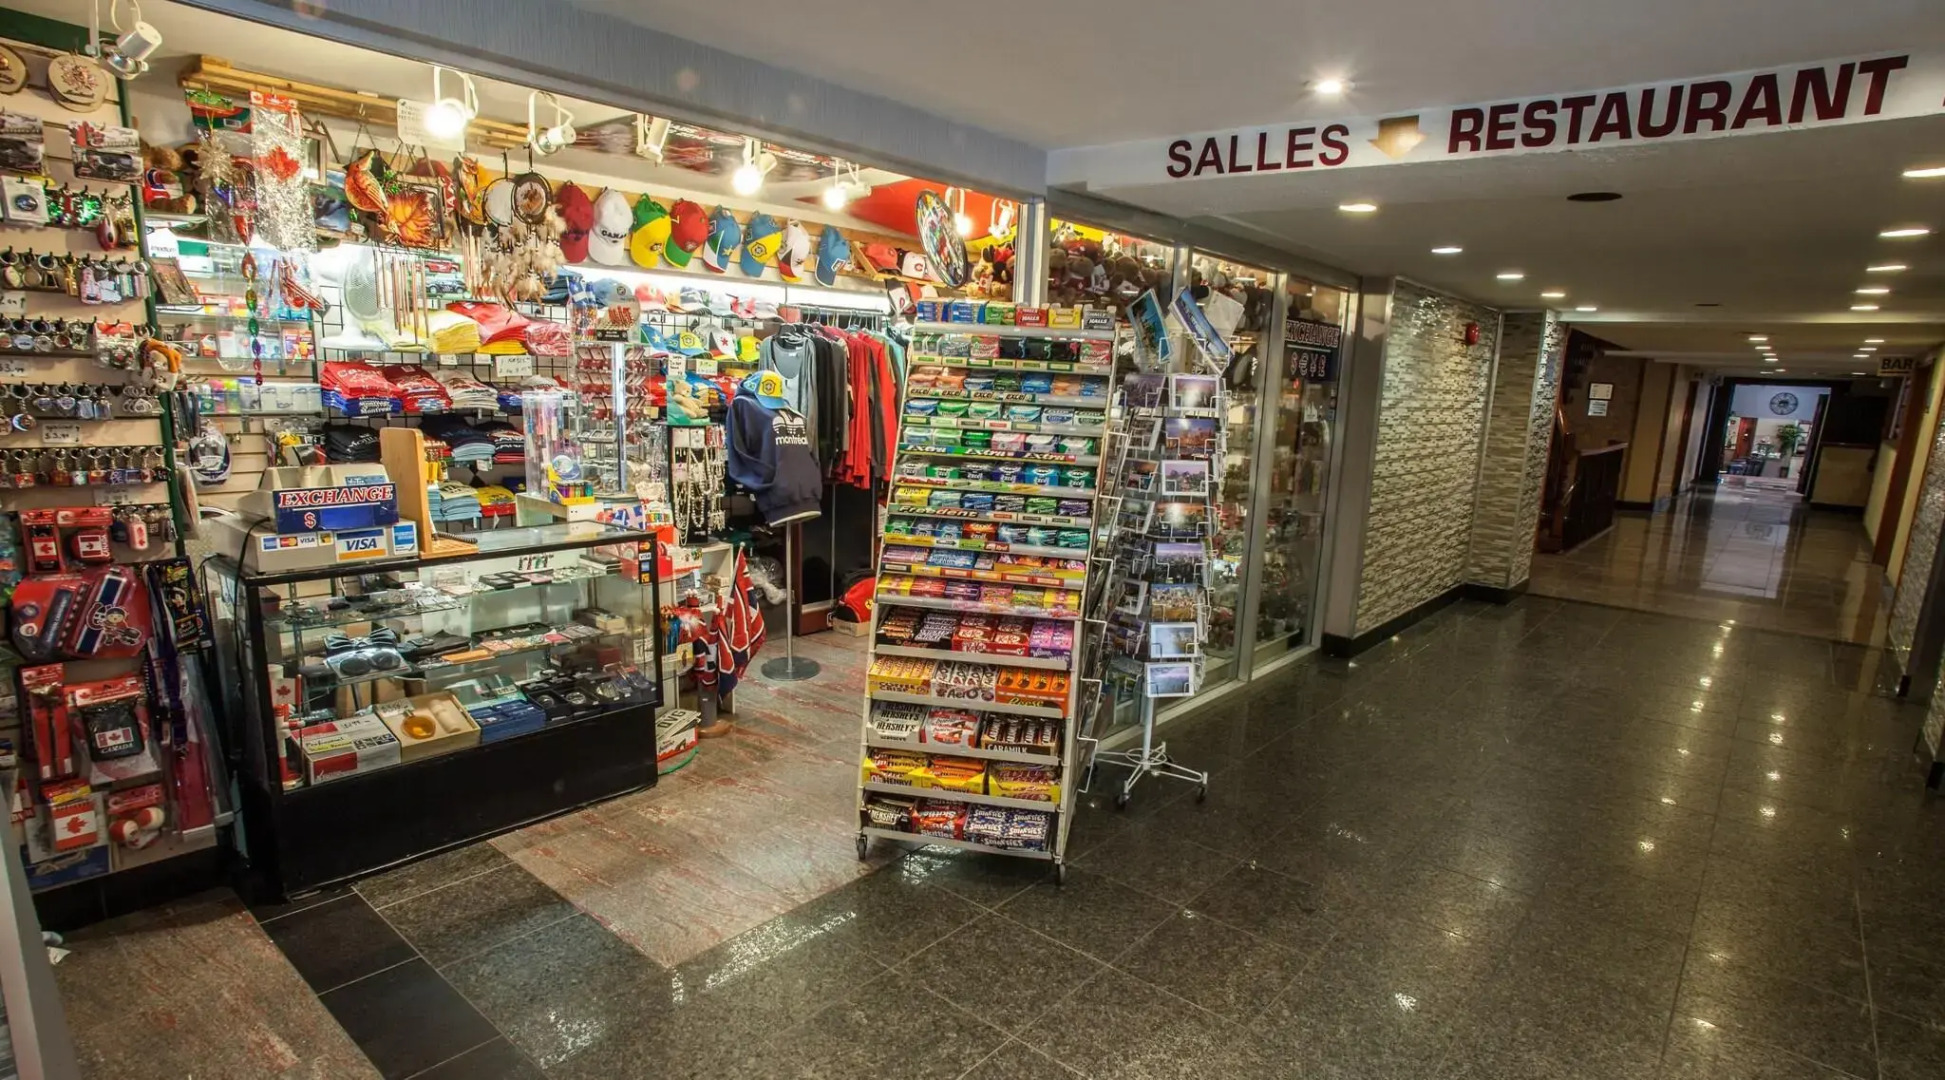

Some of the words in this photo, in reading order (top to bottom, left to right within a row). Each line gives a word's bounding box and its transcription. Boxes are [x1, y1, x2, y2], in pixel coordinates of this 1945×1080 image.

[1166, 124, 1350, 179] SALLES
[1447, 54, 1910, 154] RESTAURANT
[1882, 359, 1914, 370] BAR
[964, 447, 1006, 456] Extra
[1024, 452, 1066, 461] Extra
[278, 484, 394, 508] EXCHANGE
[898, 505, 979, 518] Freedent
[304, 512, 317, 529] $
[345, 538, 378, 551] VISA
[879, 681, 917, 690] COFFEE
[881, 710, 921, 721] HERSHEY'S
[876, 721, 917, 732] HERSHEY'S
[987, 743, 1028, 754] CARAMILK
